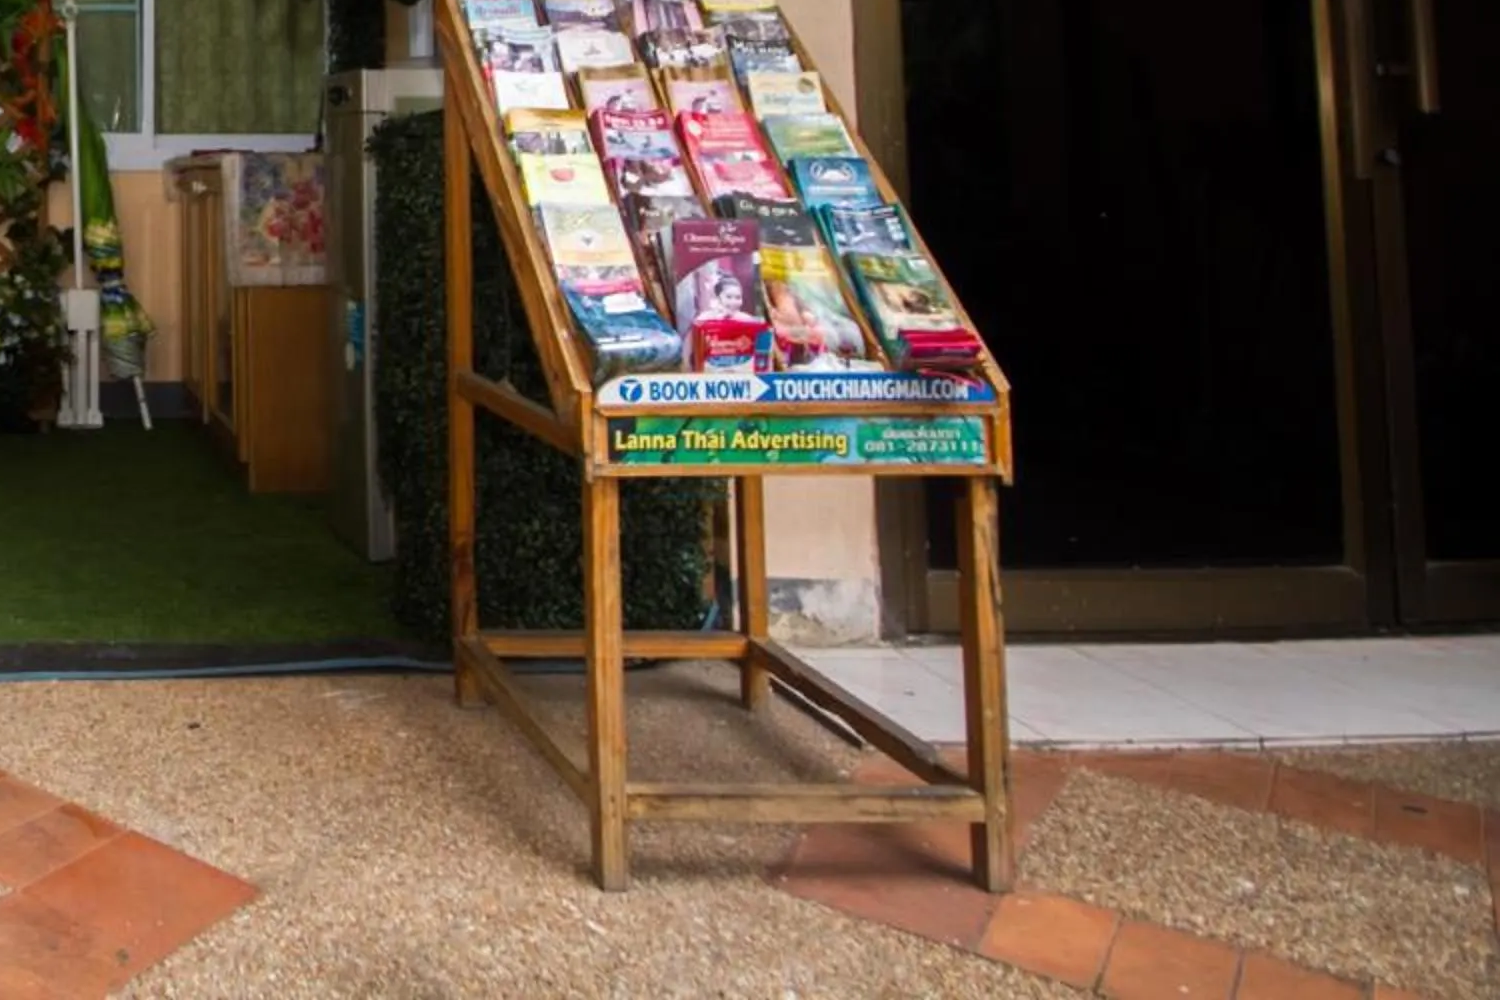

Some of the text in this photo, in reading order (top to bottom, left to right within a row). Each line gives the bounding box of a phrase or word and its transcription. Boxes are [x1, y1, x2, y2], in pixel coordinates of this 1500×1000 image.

[649, 380, 700, 400] BOOK
[705, 381, 751, 400] NOW!
[615, 428, 847, 455] Lanna Thai Advertising
